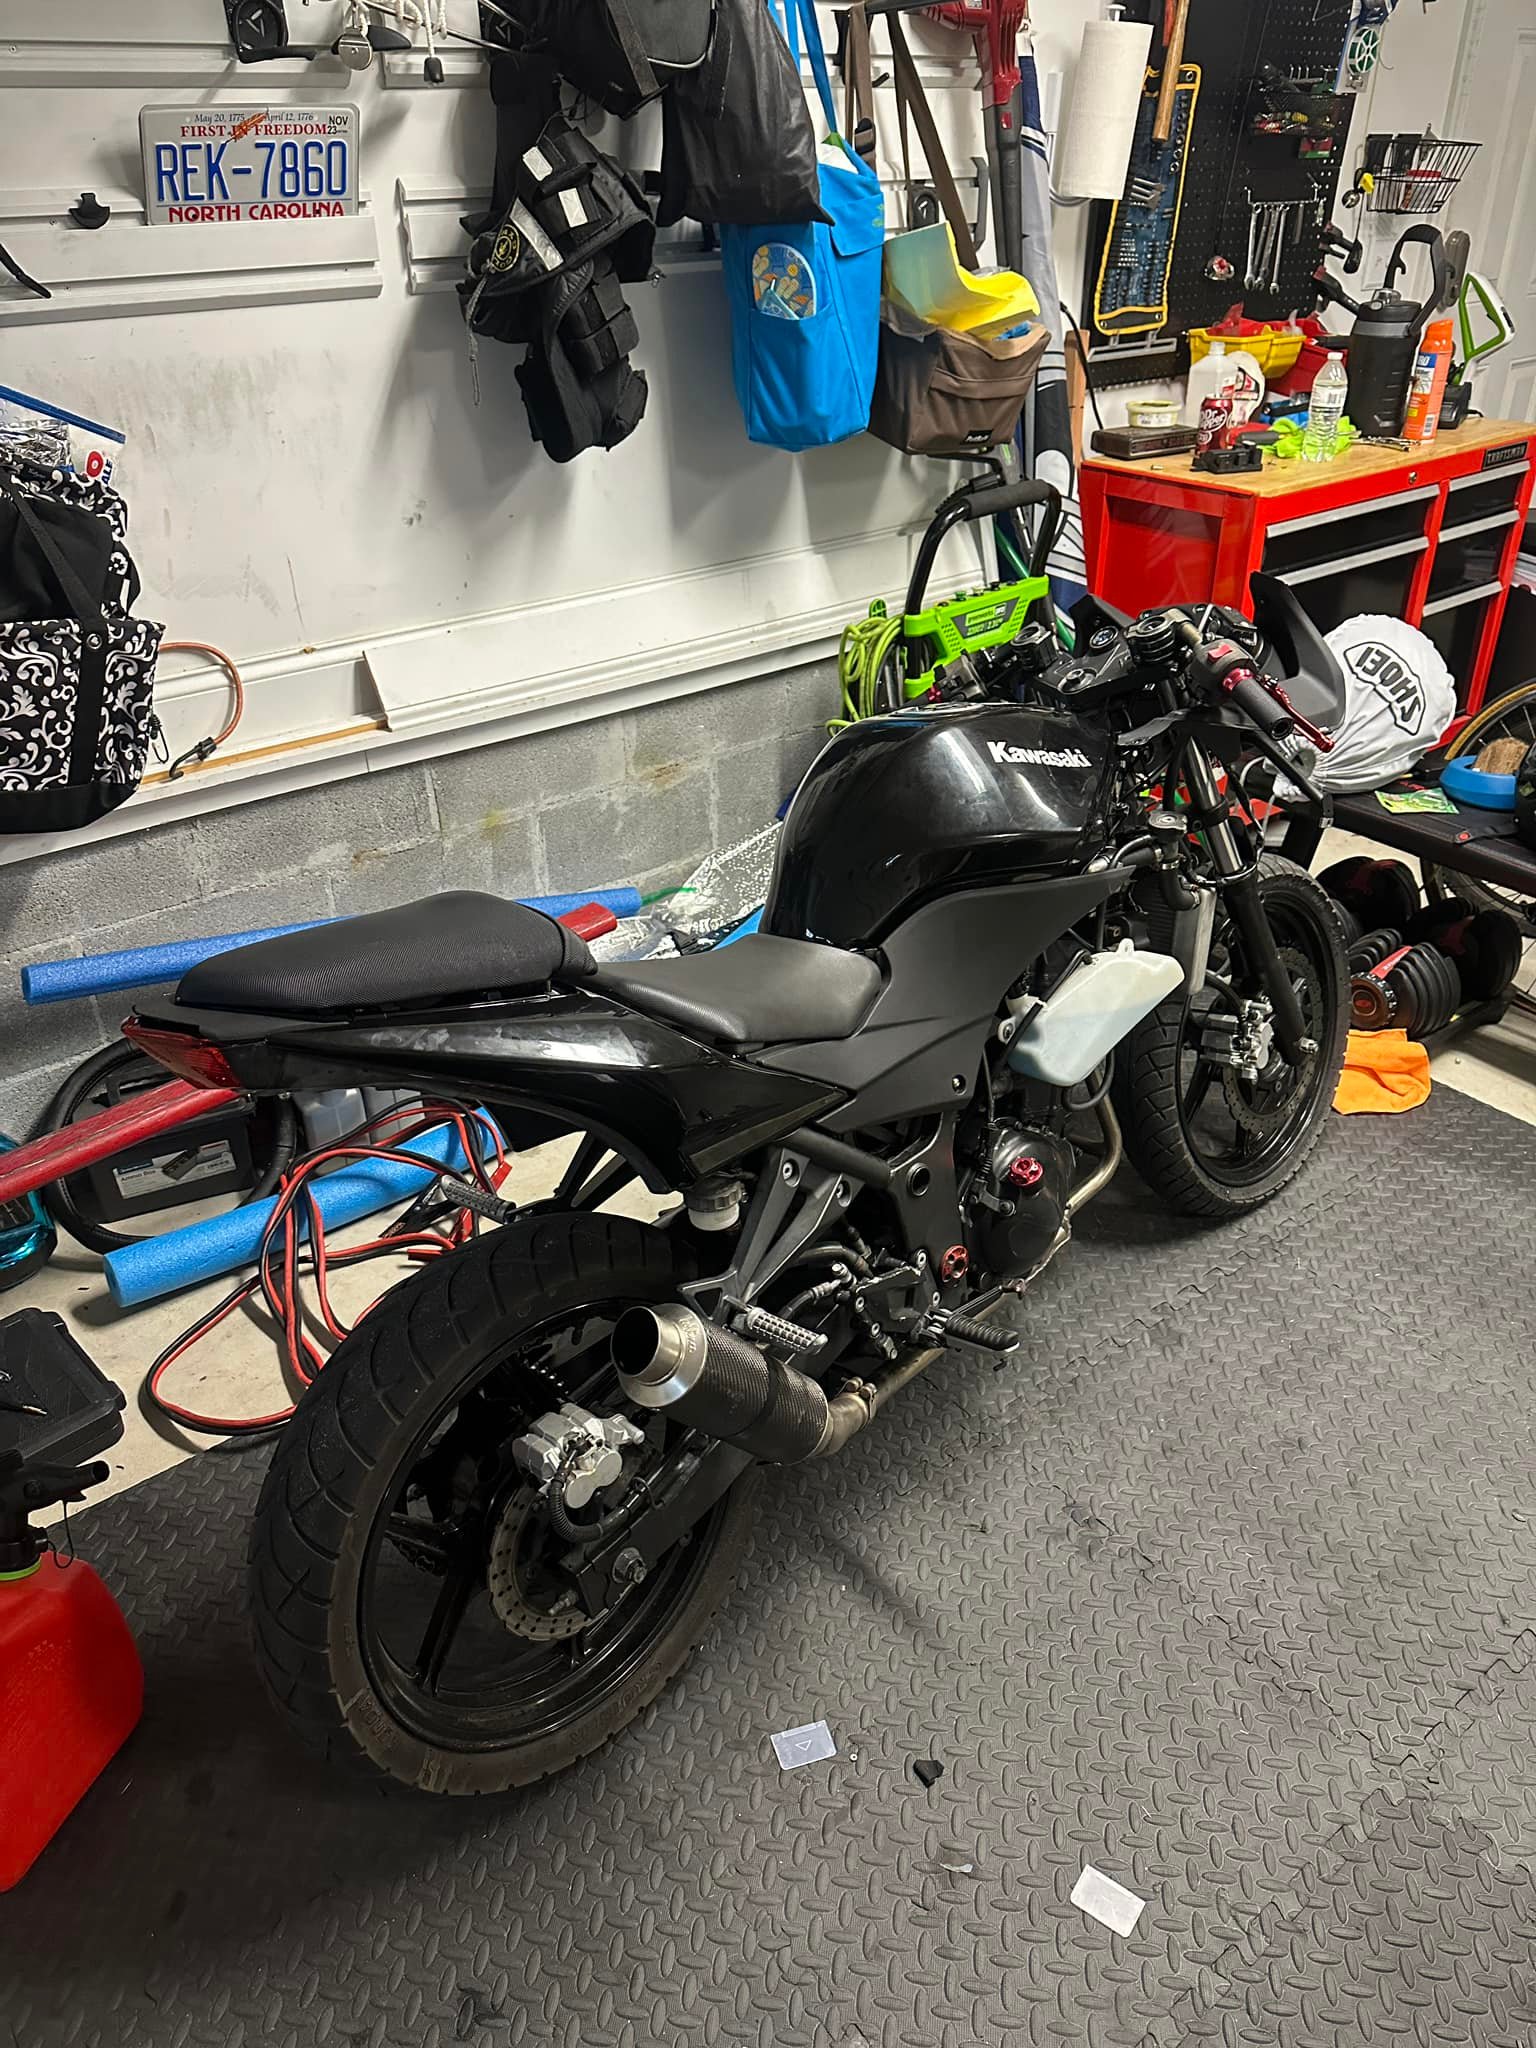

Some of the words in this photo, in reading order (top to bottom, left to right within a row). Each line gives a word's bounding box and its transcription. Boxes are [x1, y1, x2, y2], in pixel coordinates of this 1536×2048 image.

[194, 113, 212, 124] May
[214, 113, 227, 123] 20,
[229, 113, 245, 122] 1775
[267, 112, 284, 123] April
[286, 112, 296, 121] 12,
[298, 112, 314, 121] 1776
[328, 115, 348, 126] NOV
[181, 125, 226, 137] FIRST
[231, 124, 249, 136] IN
[255, 123, 327, 136] FREEDOM
[327, 125, 337, 135] 23
[155, 141, 347, 201] REK-7860
[169, 204, 241, 223] NORTH
[249, 201, 344, 221] CAROLINA
[1355, 646, 1421, 722] SHOEI
[986, 741, 1093, 768] Kawasaki
